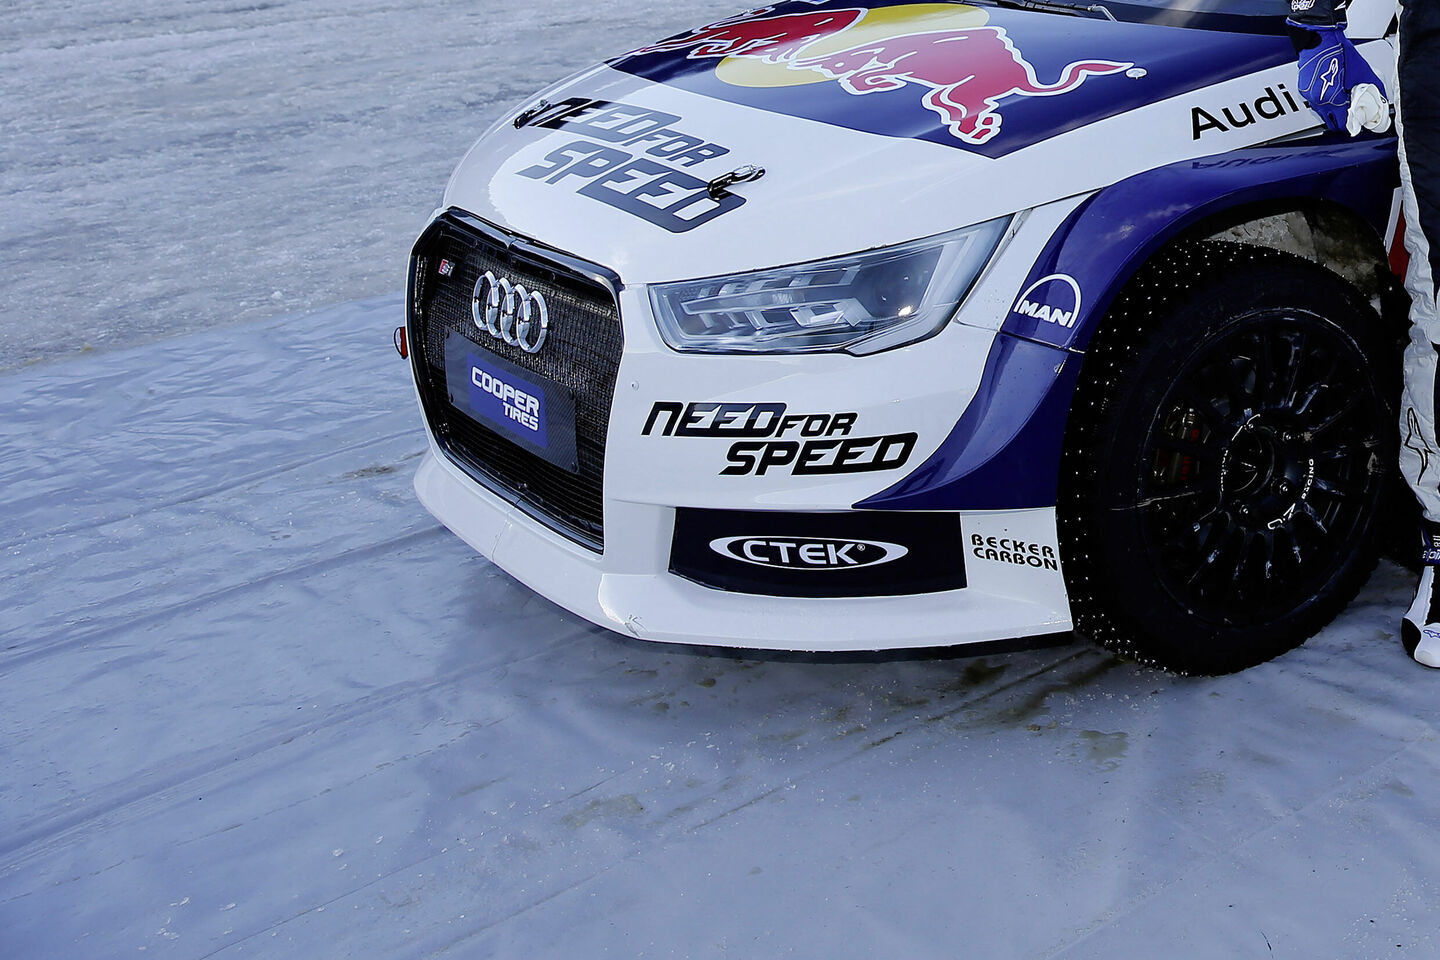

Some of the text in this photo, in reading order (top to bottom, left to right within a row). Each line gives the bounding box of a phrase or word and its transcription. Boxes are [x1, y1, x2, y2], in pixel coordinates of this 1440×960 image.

[529, 97, 731, 167] NEED FOR
[515, 140, 748, 233] SPEED
[1014, 300, 1073, 327] MAN
[471, 366, 540, 415] COOPER
[503, 401, 539, 431] TIRES
[641, 401, 858, 438] NEED FOR
[718, 432, 919, 476] SPEED
[743, 539, 860, 565] CTEK
[971, 533, 1055, 559] BECKER
[973, 547, 1058, 571] CARBON
